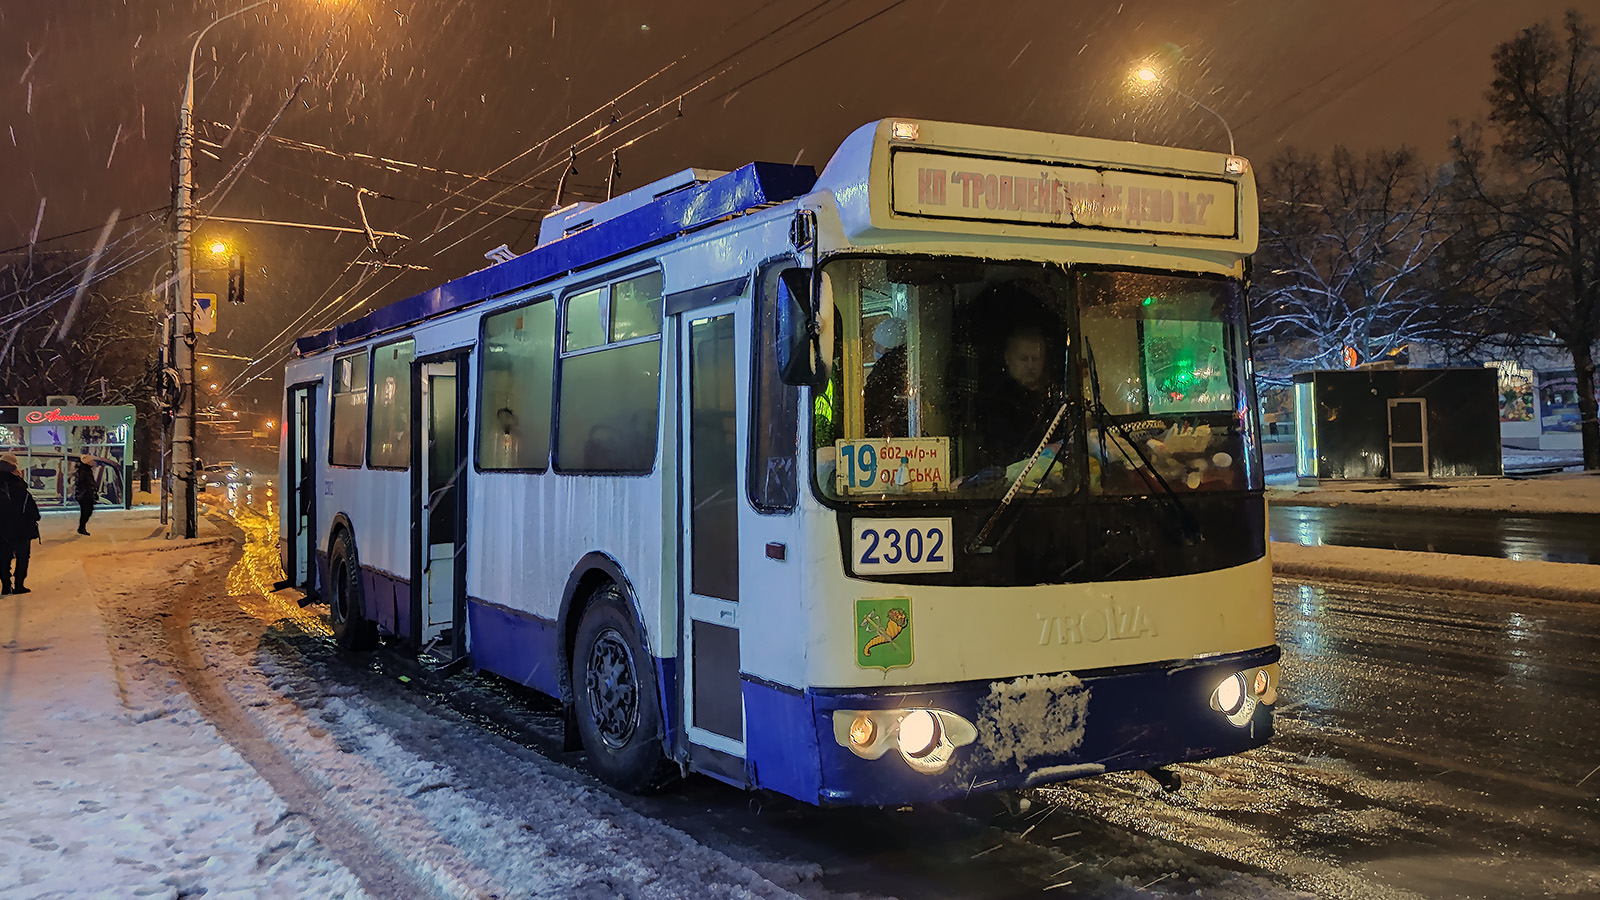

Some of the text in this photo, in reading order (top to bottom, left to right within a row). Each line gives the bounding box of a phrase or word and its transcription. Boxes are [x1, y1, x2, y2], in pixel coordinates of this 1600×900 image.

[918, 168, 947, 206] КП
[1126, 186, 1174, 226] ДЕПО
[841, 444, 878, 488] 19
[880, 446, 937, 462] 602 м/р-н
[880, 467, 942, 486] ОДСЬКА
[860, 528, 944, 564] 2302
